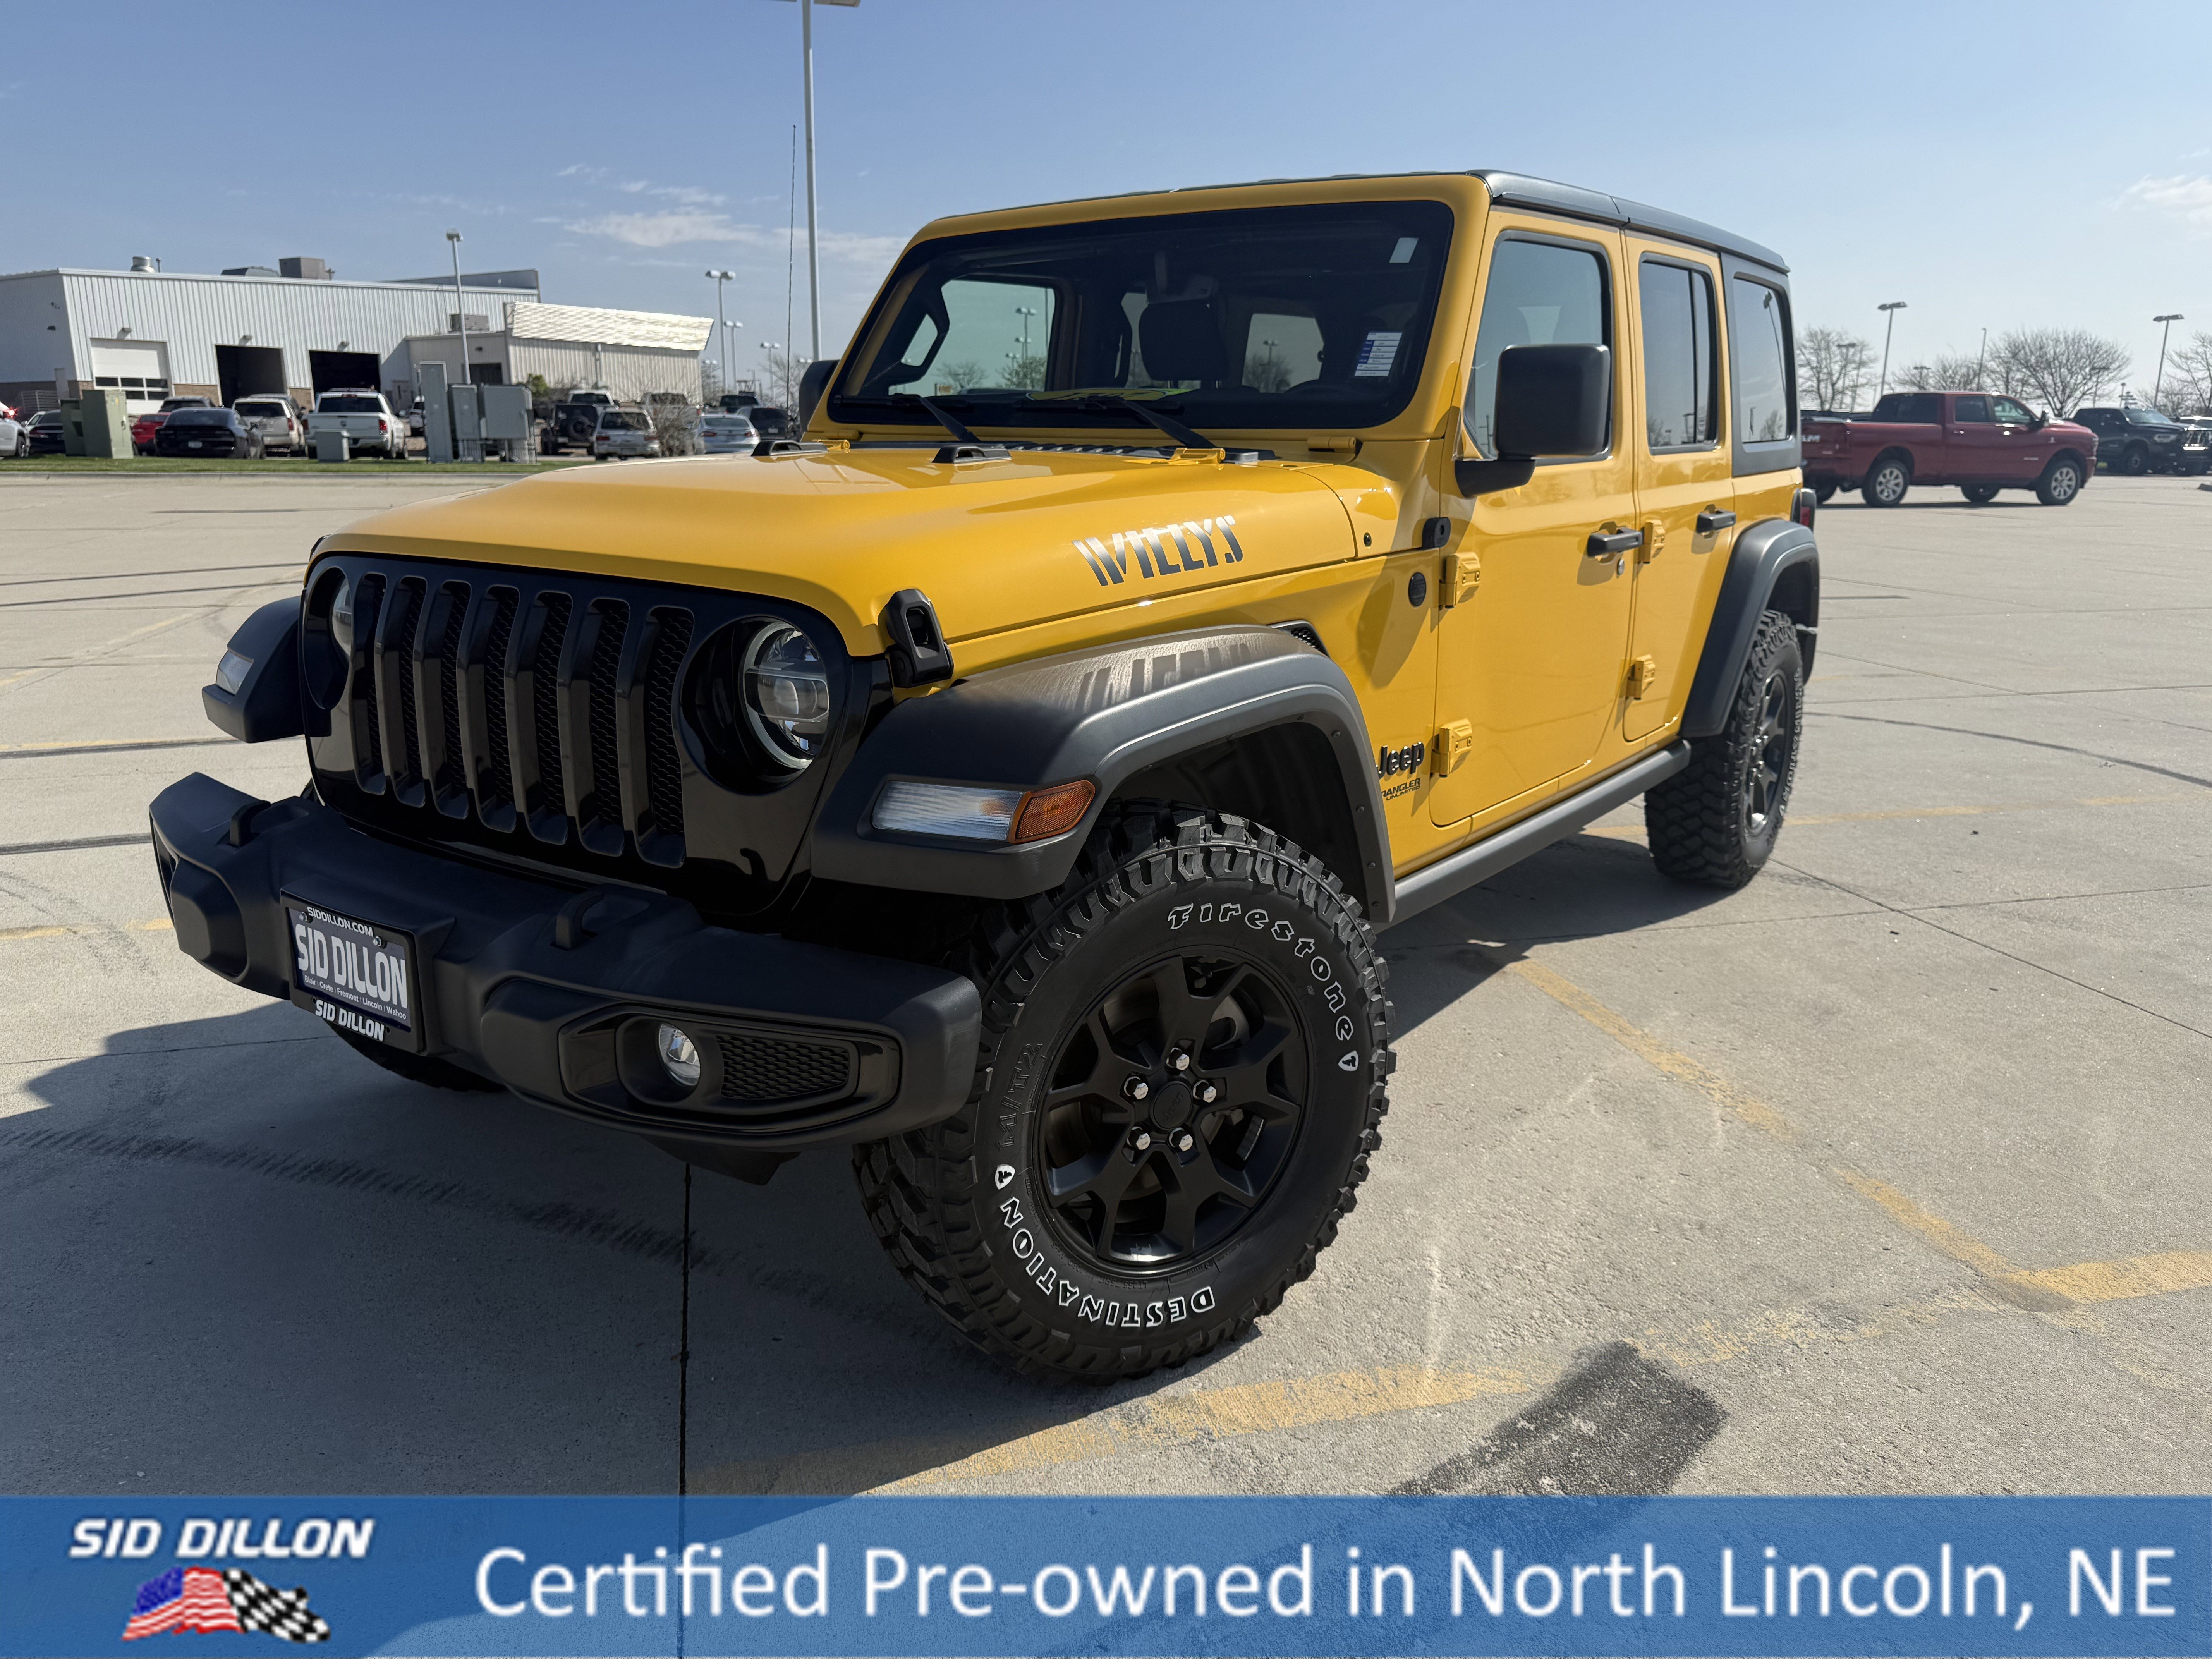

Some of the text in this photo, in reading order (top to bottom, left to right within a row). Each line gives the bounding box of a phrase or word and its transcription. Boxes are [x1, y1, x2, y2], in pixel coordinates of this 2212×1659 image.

[1072, 515, 1243, 586] WILLYS
[1376, 741, 1425, 780] Jeep
[1381, 778, 1420, 798] RANGLER
[1386, 786, 1420, 800] UNLIMITED
[307, 906, 374, 937] SIDDILLON.COM
[295, 924, 407, 1009] SID DILLON
[1168, 903, 1353, 1041] Firestone
[305, 975, 407, 1020] Blair Crete Fremont Lincoln Wahoo
[315, 1000, 385, 1041] SID DILLON
[1000, 1197, 1215, 1327] DESTINATION
